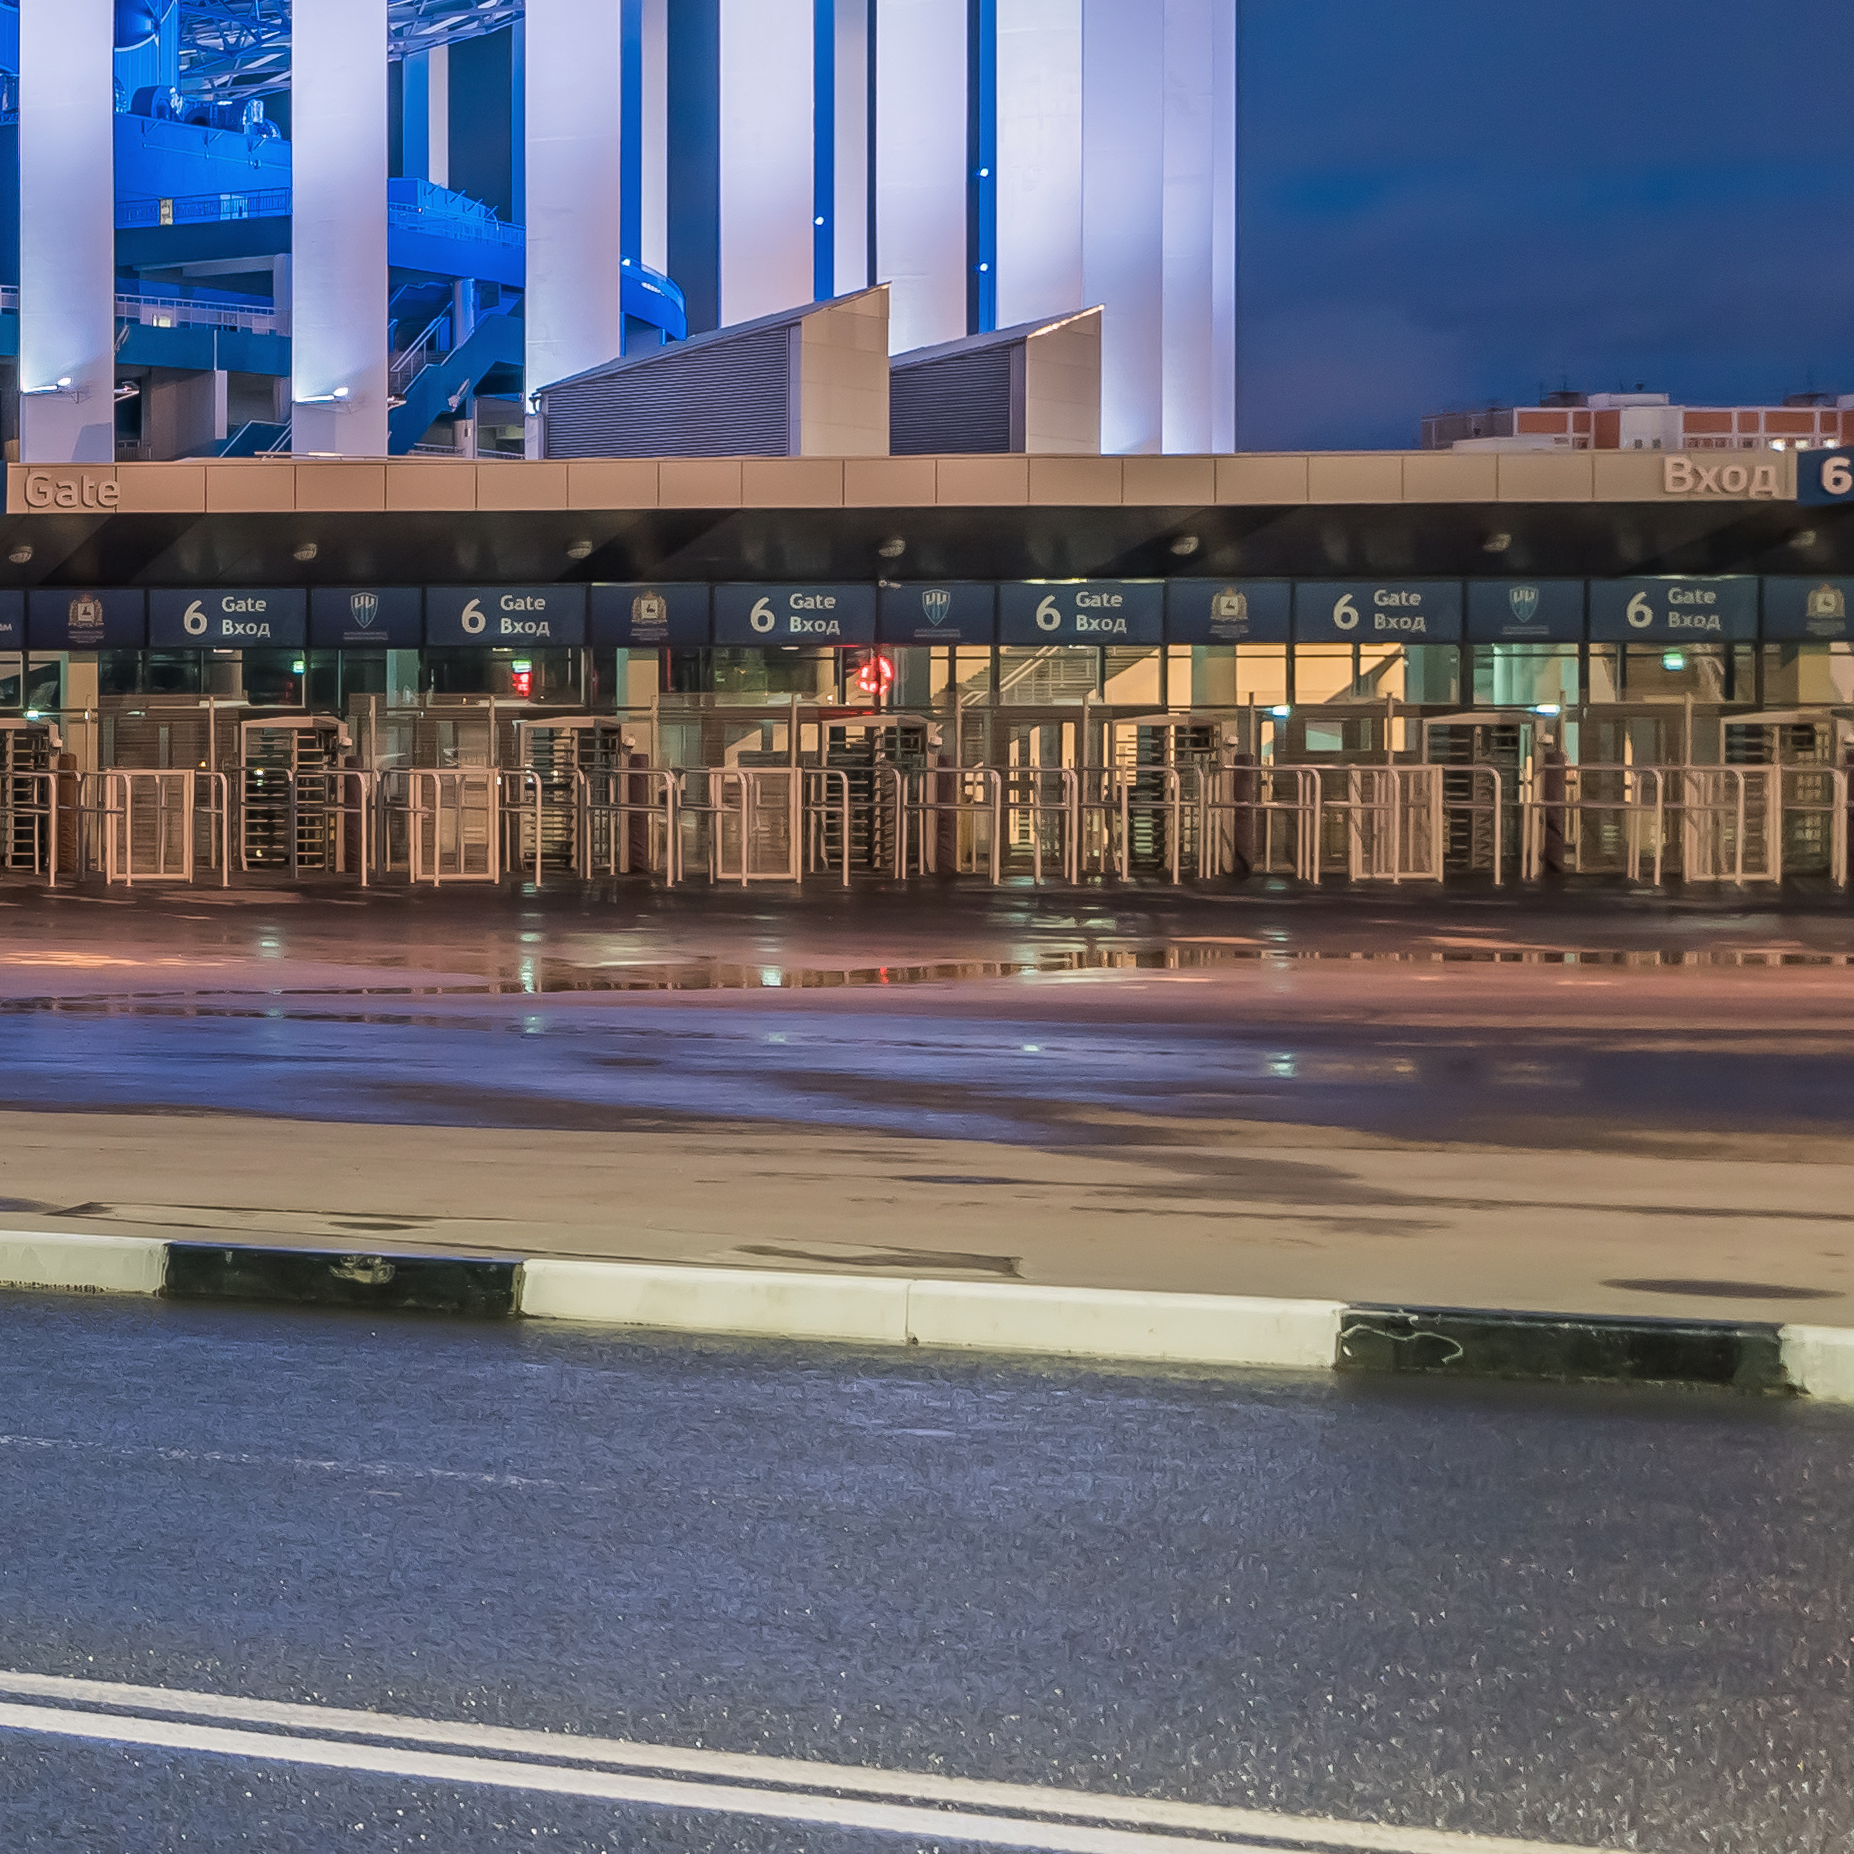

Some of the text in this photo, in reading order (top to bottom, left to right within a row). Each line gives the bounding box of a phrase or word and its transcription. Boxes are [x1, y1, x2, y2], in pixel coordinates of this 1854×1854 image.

[1662, 456, 1854, 500] Вход 6
[24, 471, 122, 510] Gate
[221, 596, 267, 613] Gate
[499, 594, 546, 611] Gate
[789, 592, 836, 610] Gate
[1075, 591, 1123, 608] Gate
[1374, 588, 1422, 607] Gate
[1667, 586, 1716, 604] Gate
[183, 600, 208, 636] 6
[461, 598, 487, 634] 6
[749, 596, 776, 634] 6
[1036, 595, 1062, 632] 6
[1332, 592, 1360, 630] 6
[1626, 591, 1654, 628] 6
[221, 619, 271, 638] Вход
[499, 618, 551, 637] Вход
[789, 616, 840, 636] Вход
[1075, 614, 1128, 634] Вход
[1374, 612, 1427, 633] Вход
[1667, 610, 1721, 631] Вход
